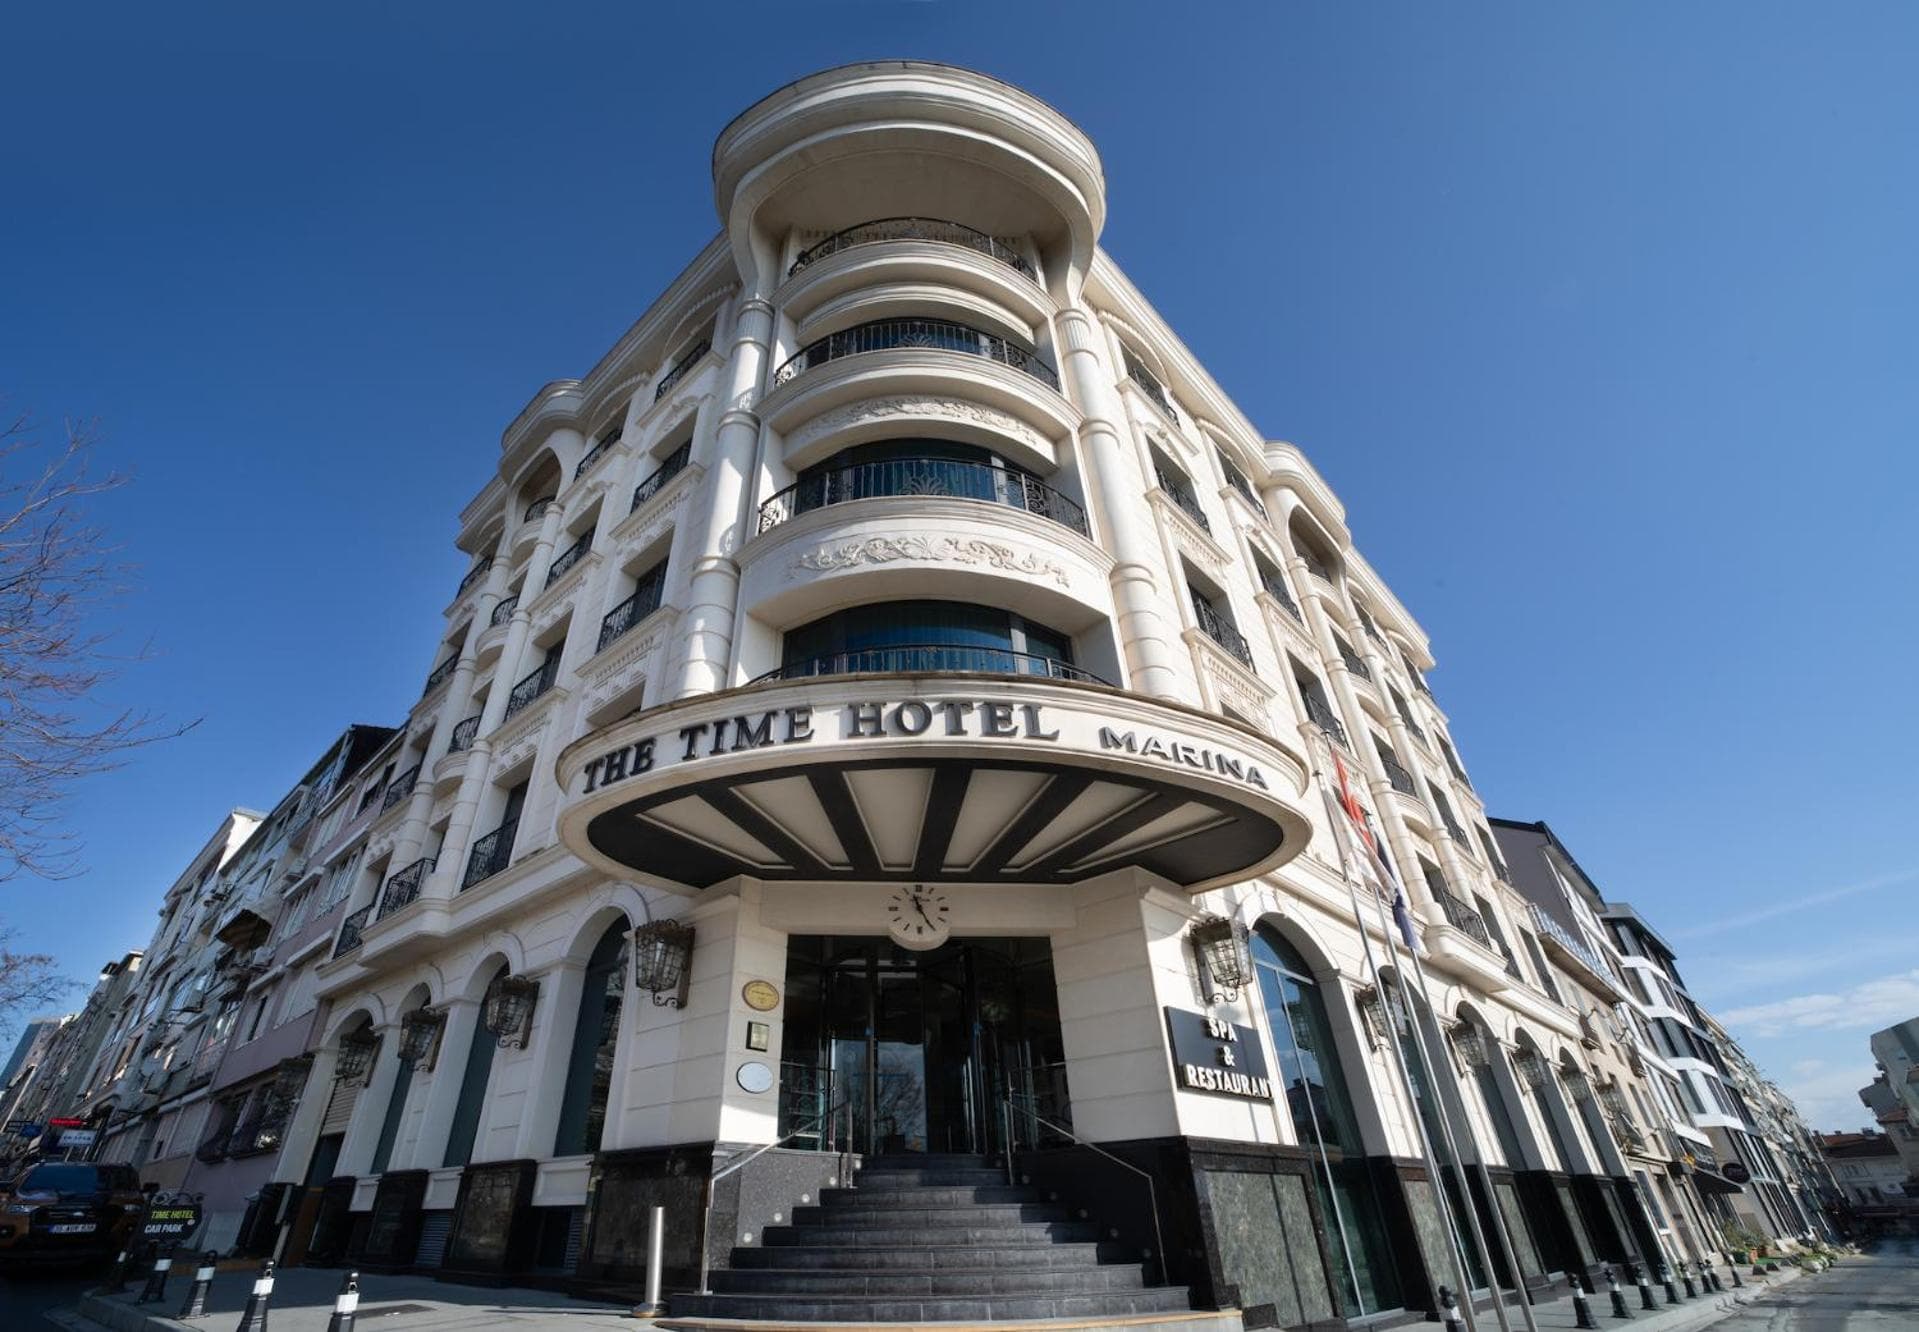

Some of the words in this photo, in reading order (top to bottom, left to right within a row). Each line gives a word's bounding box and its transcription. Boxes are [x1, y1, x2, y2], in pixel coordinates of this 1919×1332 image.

[582, 736, 657, 794] THE
[679, 705, 815, 761] TIME
[842, 700, 1061, 742] HOTEL
[1097, 726, 1269, 791] MARINA
[1207, 1017, 1239, 1042] SPA
[1221, 1044, 1236, 1067] &
[1184, 1063, 1275, 1098] RESTAURANT
[144, 1224, 162, 1234] CAR
[162, 1223, 184, 1233] PARK
